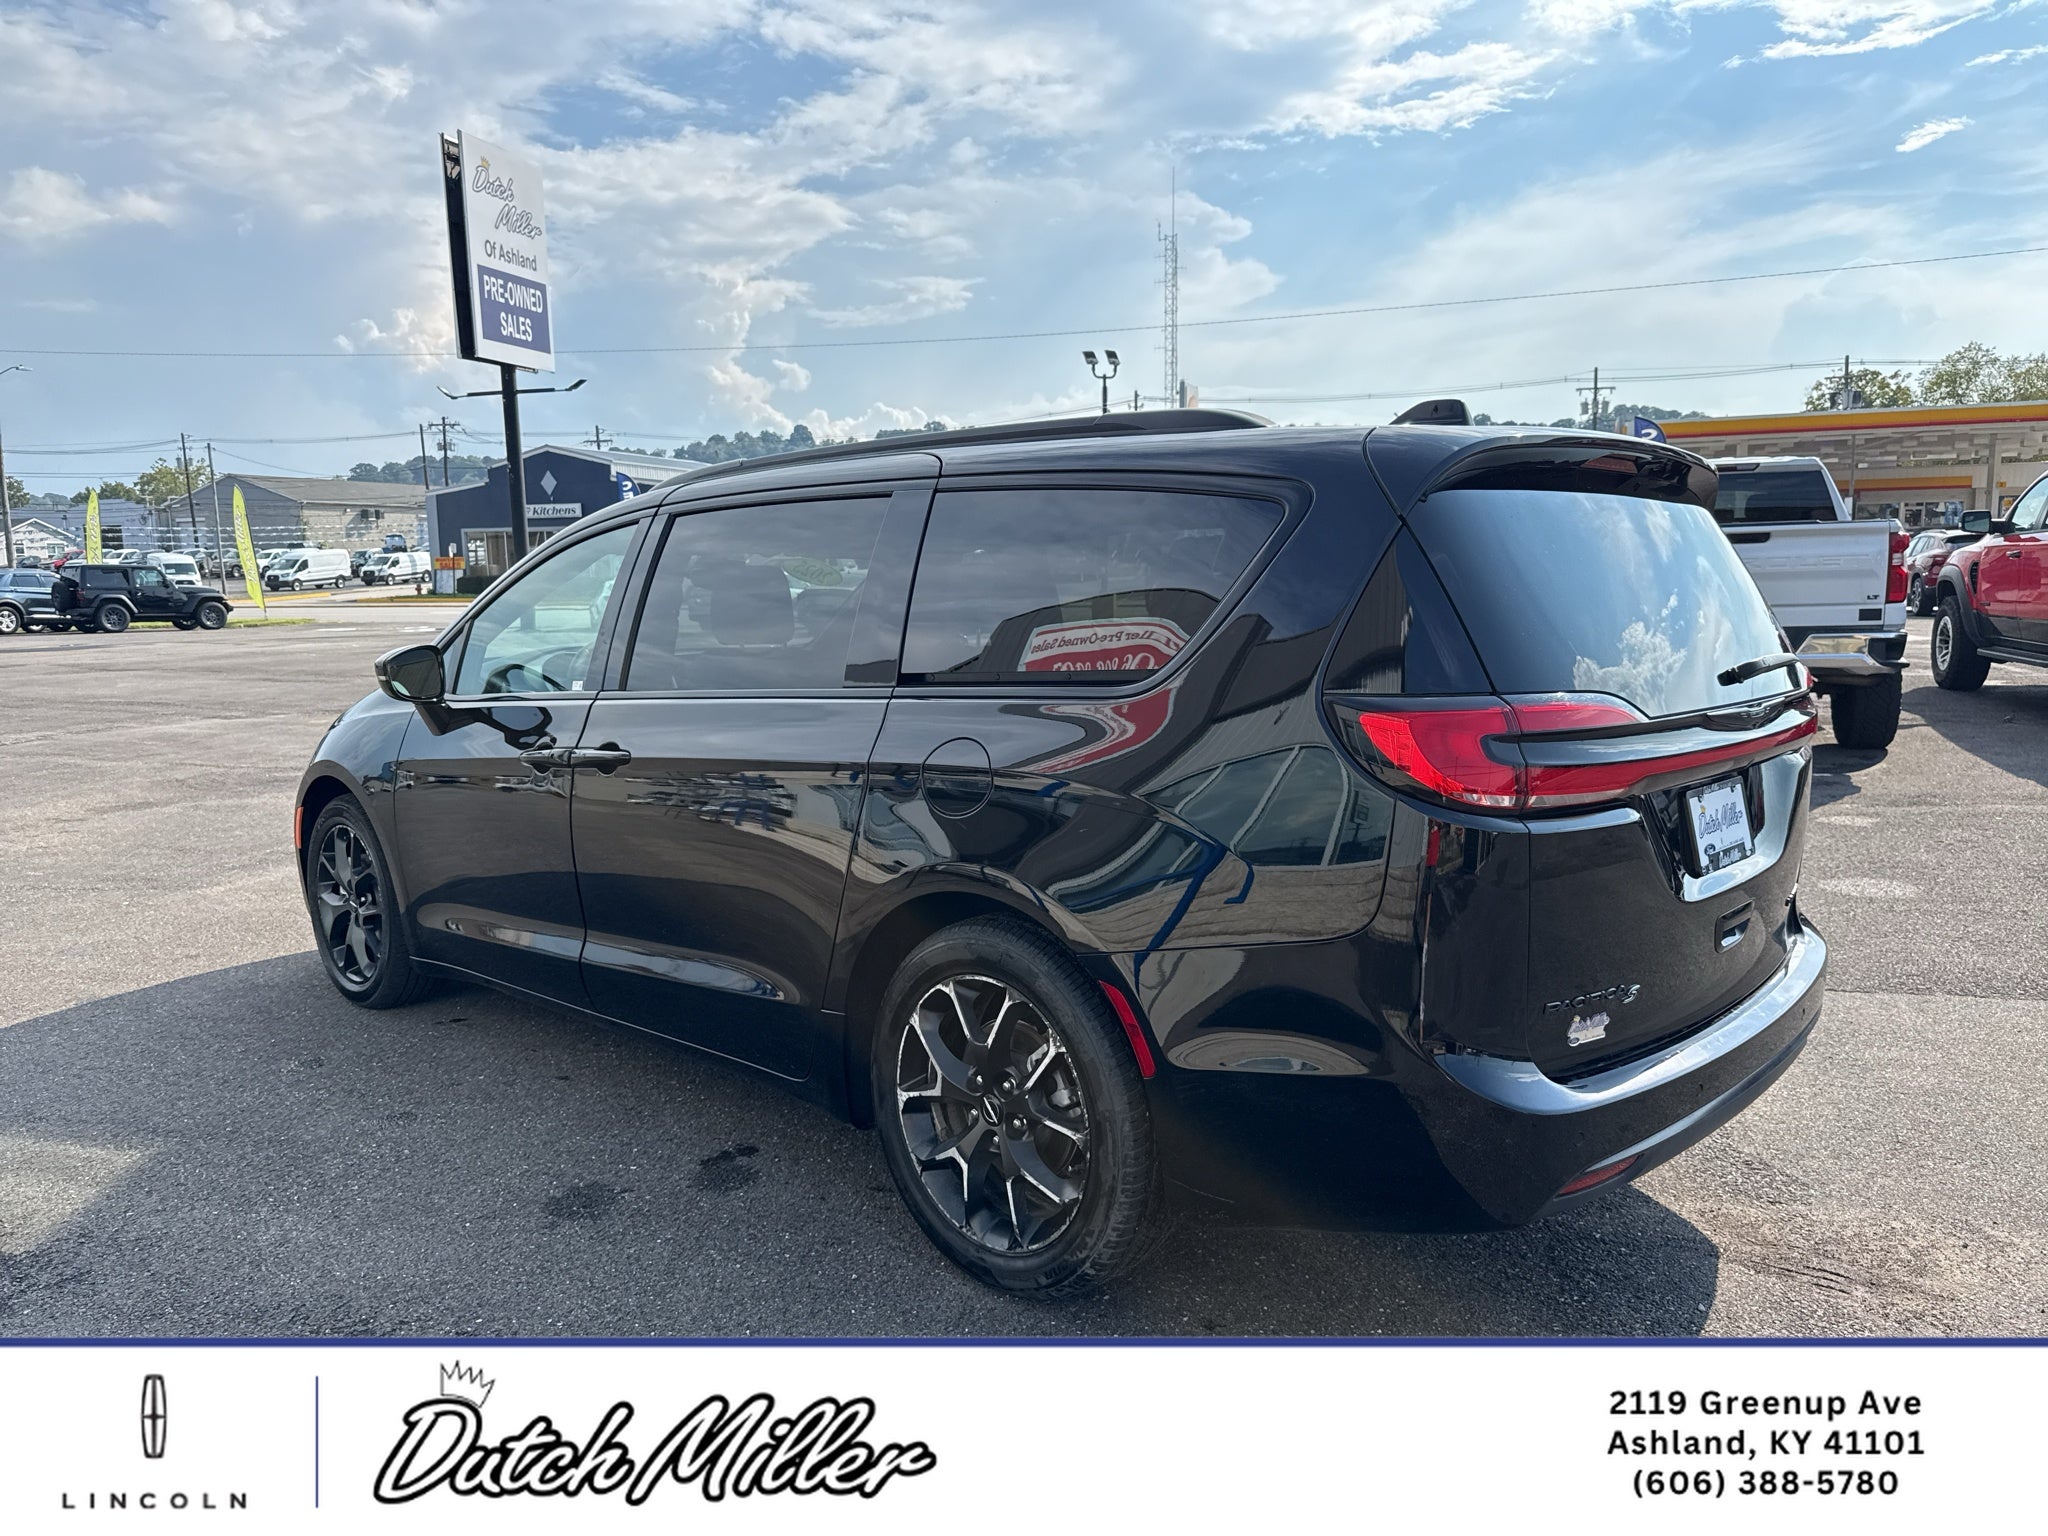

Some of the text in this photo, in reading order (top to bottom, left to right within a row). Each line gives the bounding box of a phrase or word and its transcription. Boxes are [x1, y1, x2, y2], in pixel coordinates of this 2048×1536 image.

[472, 165, 514, 203] Dutch
[495, 203, 543, 241] Miller
[484, 239, 537, 272] Of Ashland
[483, 274, 543, 314] PRE-OWNED
[500, 311, 533, 342] SALES
[532, 506, 577, 516] Kitchens
[1699, 801, 1744, 839] Dutch Miller
[1543, 984, 1625, 1014] PACIFICA
